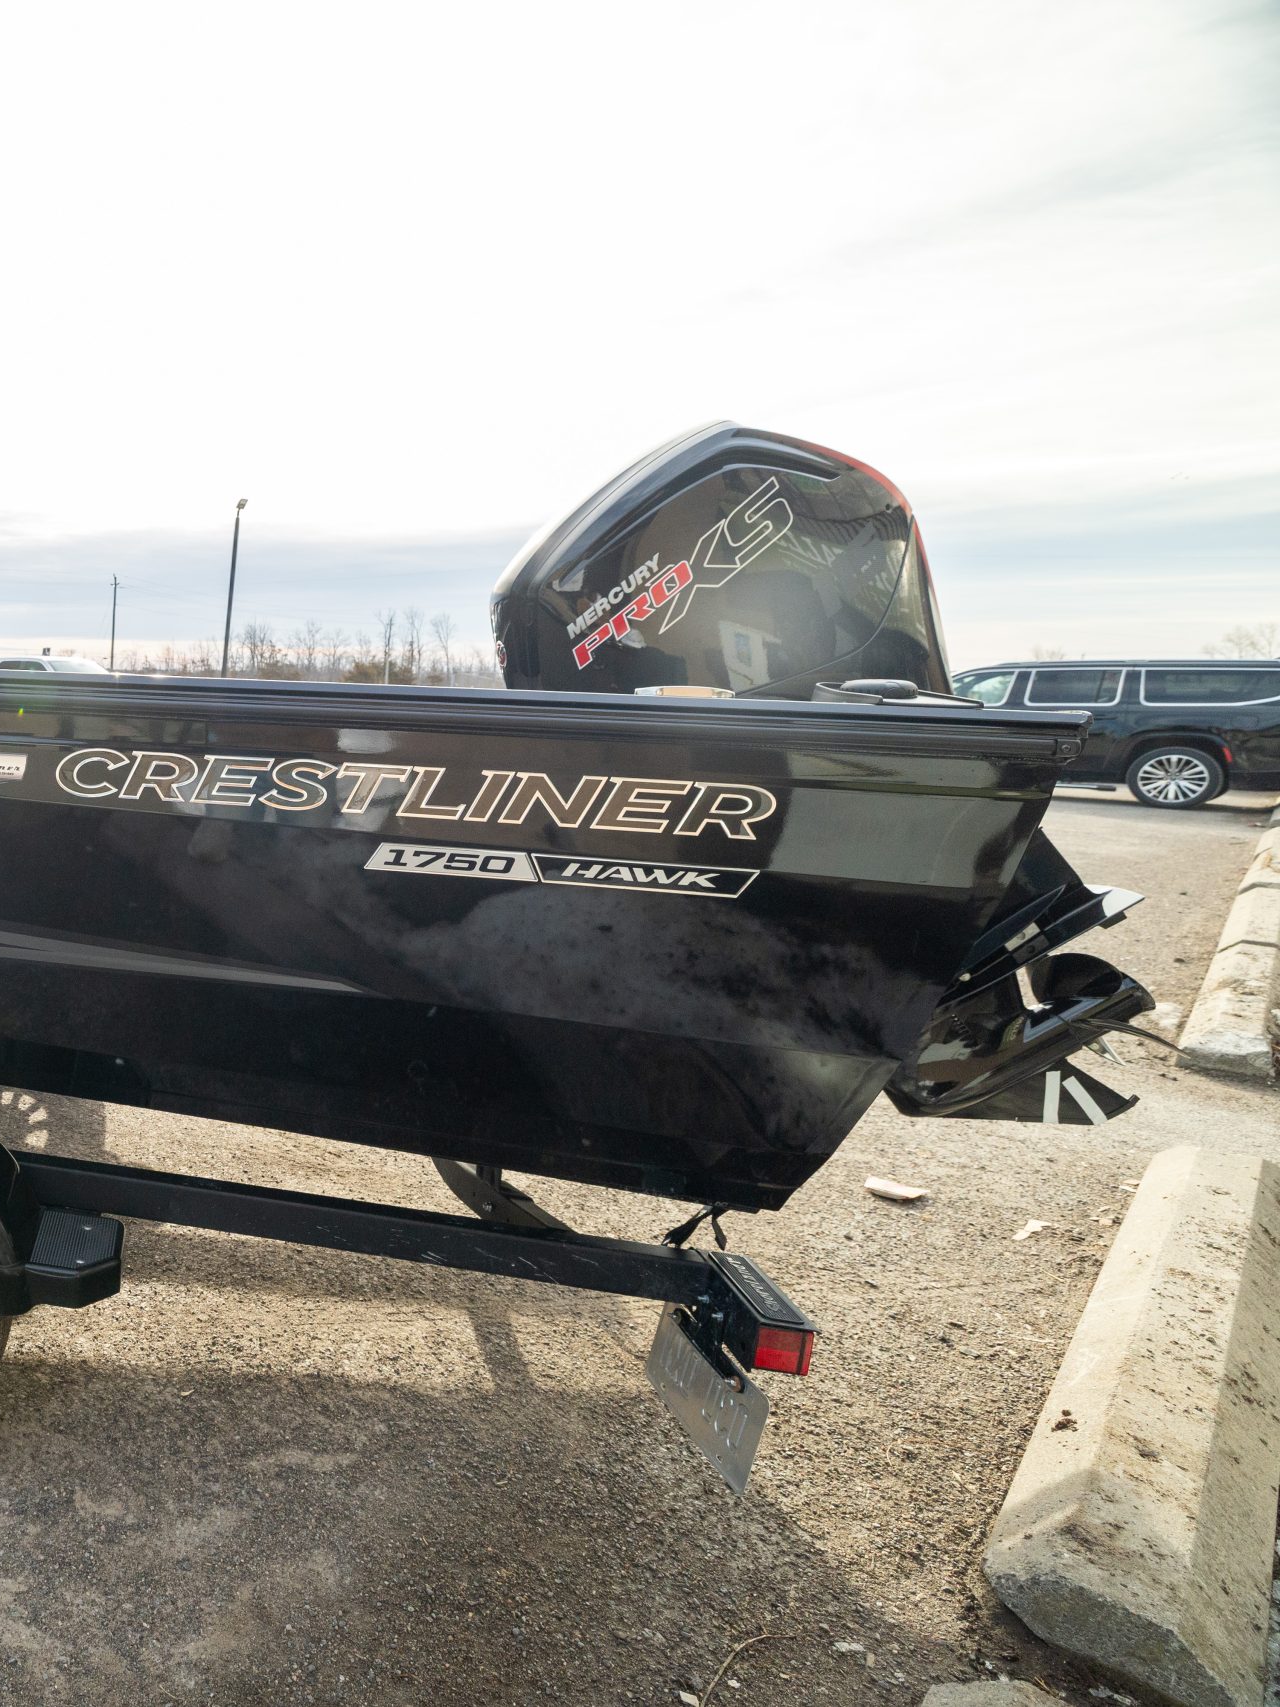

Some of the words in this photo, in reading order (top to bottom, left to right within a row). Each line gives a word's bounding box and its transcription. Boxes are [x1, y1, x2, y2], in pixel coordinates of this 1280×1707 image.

[566, 552, 660, 639] MERCURY
[572, 560, 693, 670] PRO
[645, 476, 793, 635] XS
[56, 748, 776, 840] CRESTLINER
[384, 849, 515, 873] 1750
[561, 862, 720, 888] HAWK
